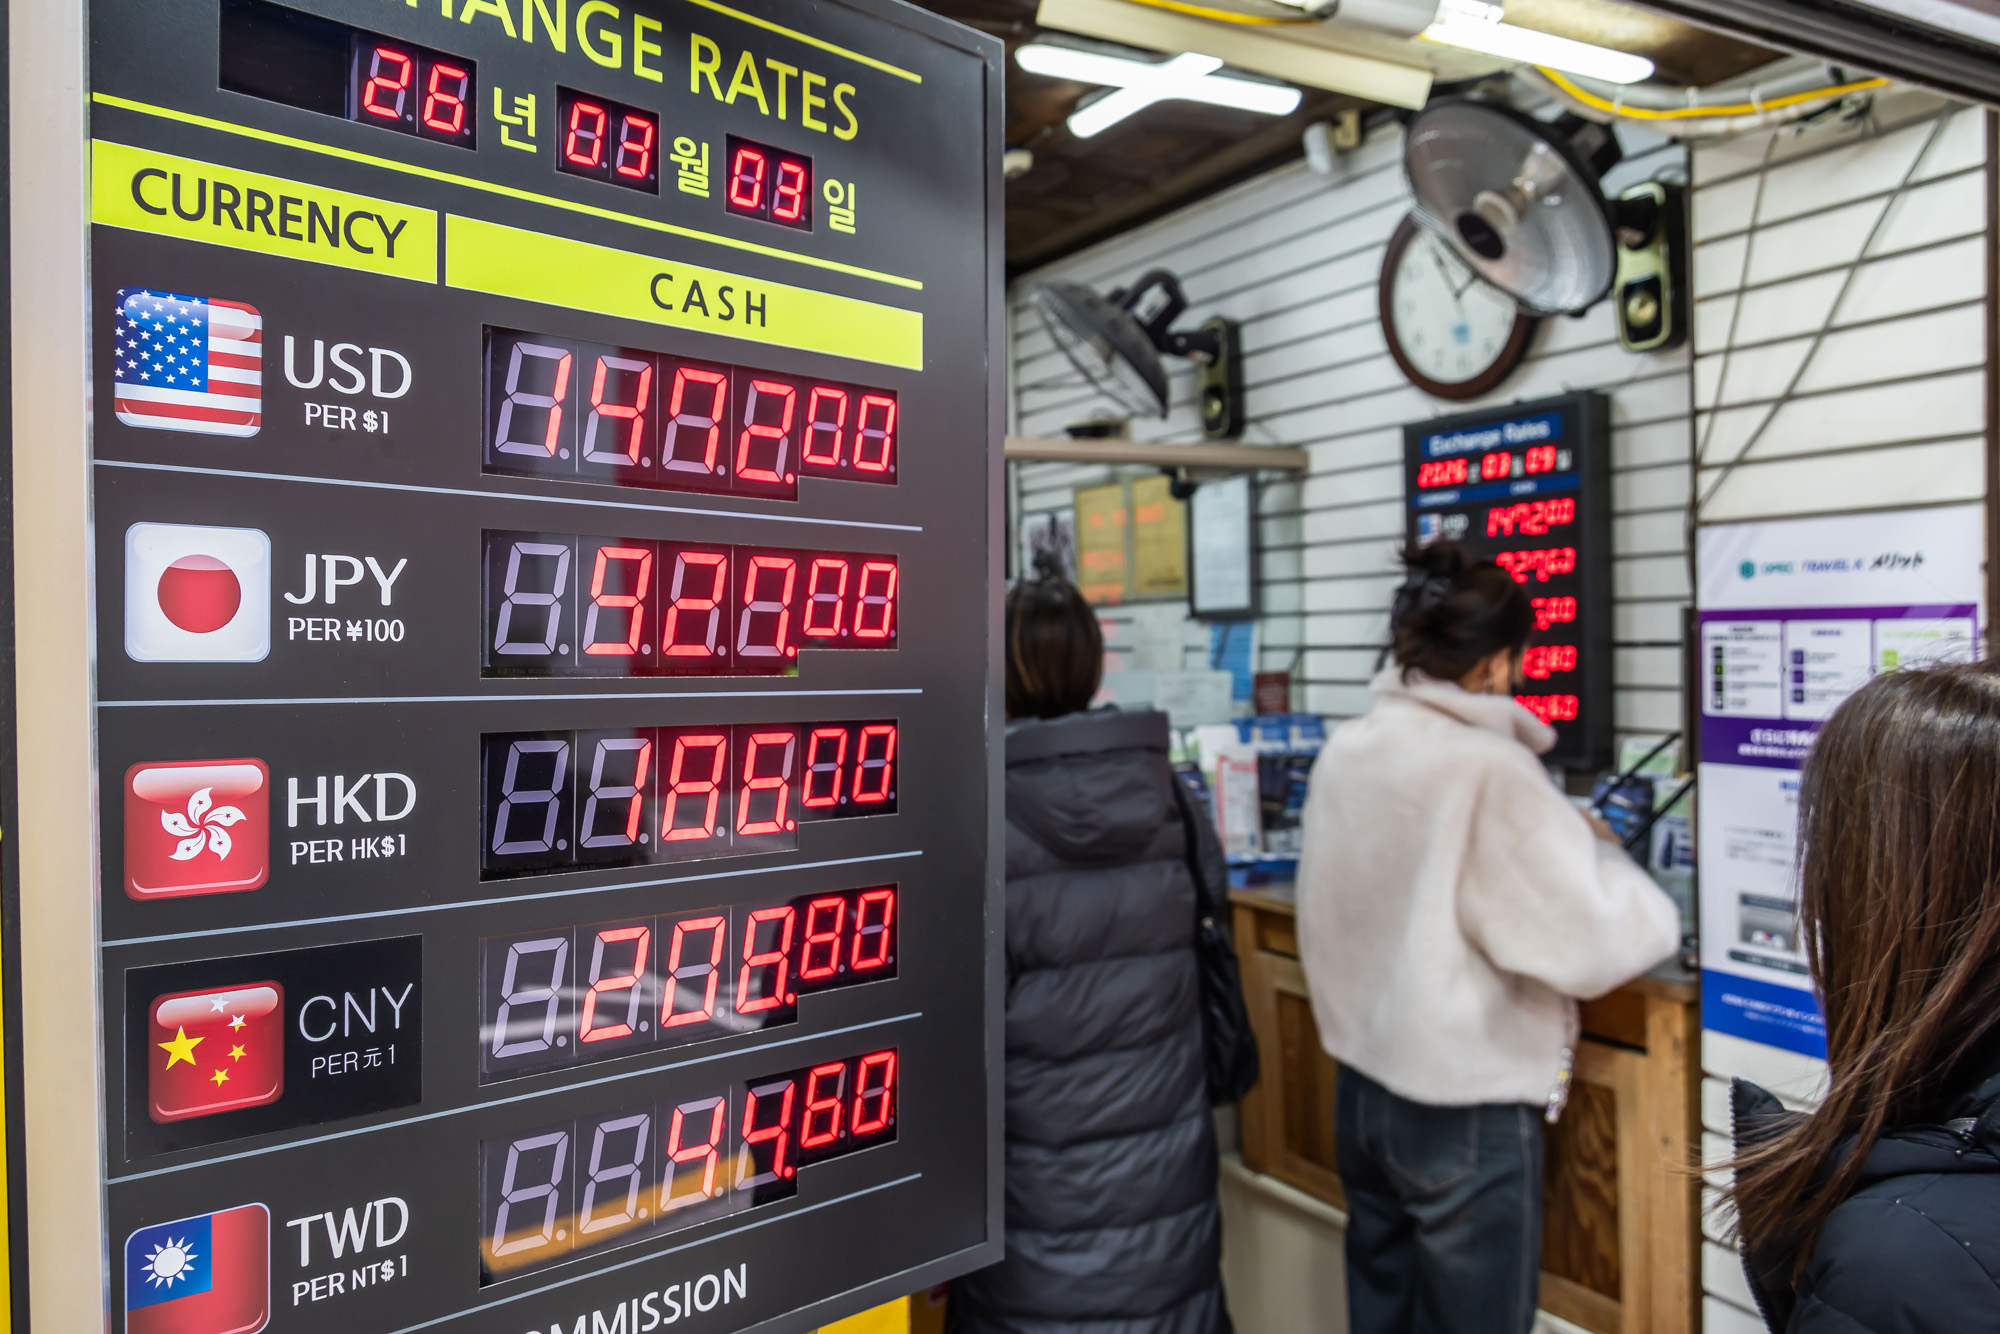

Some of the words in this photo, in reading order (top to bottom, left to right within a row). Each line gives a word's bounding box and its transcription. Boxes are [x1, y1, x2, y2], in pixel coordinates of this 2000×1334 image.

[690, 33, 859, 141] RATES
[363, 47, 468, 133] 26
[493, 87, 537, 154] 년
[564, 101, 654, 179] 03
[670, 134, 711, 199] 월
[730, 149, 806, 220] 03
[823, 178, 858, 235] 일
[130, 167, 408, 259] CURRENCY
[650, 272, 769, 329] CASH
[283, 335, 413, 399] USD
[304, 402, 356, 430] PER
[362, 409, 389, 434] $1
[284, 554, 408, 606] JPY
[288, 617, 341, 641] PER
[346, 618, 405, 642] ¥100
[287, 773, 417, 828] HKD
[290, 838, 343, 865] PER
[299, 983, 413, 1042] CNY
[312, 1051, 358, 1078] PER
[286, 1196, 409, 1268] TWD
[292, 1272, 345, 1306] PER
